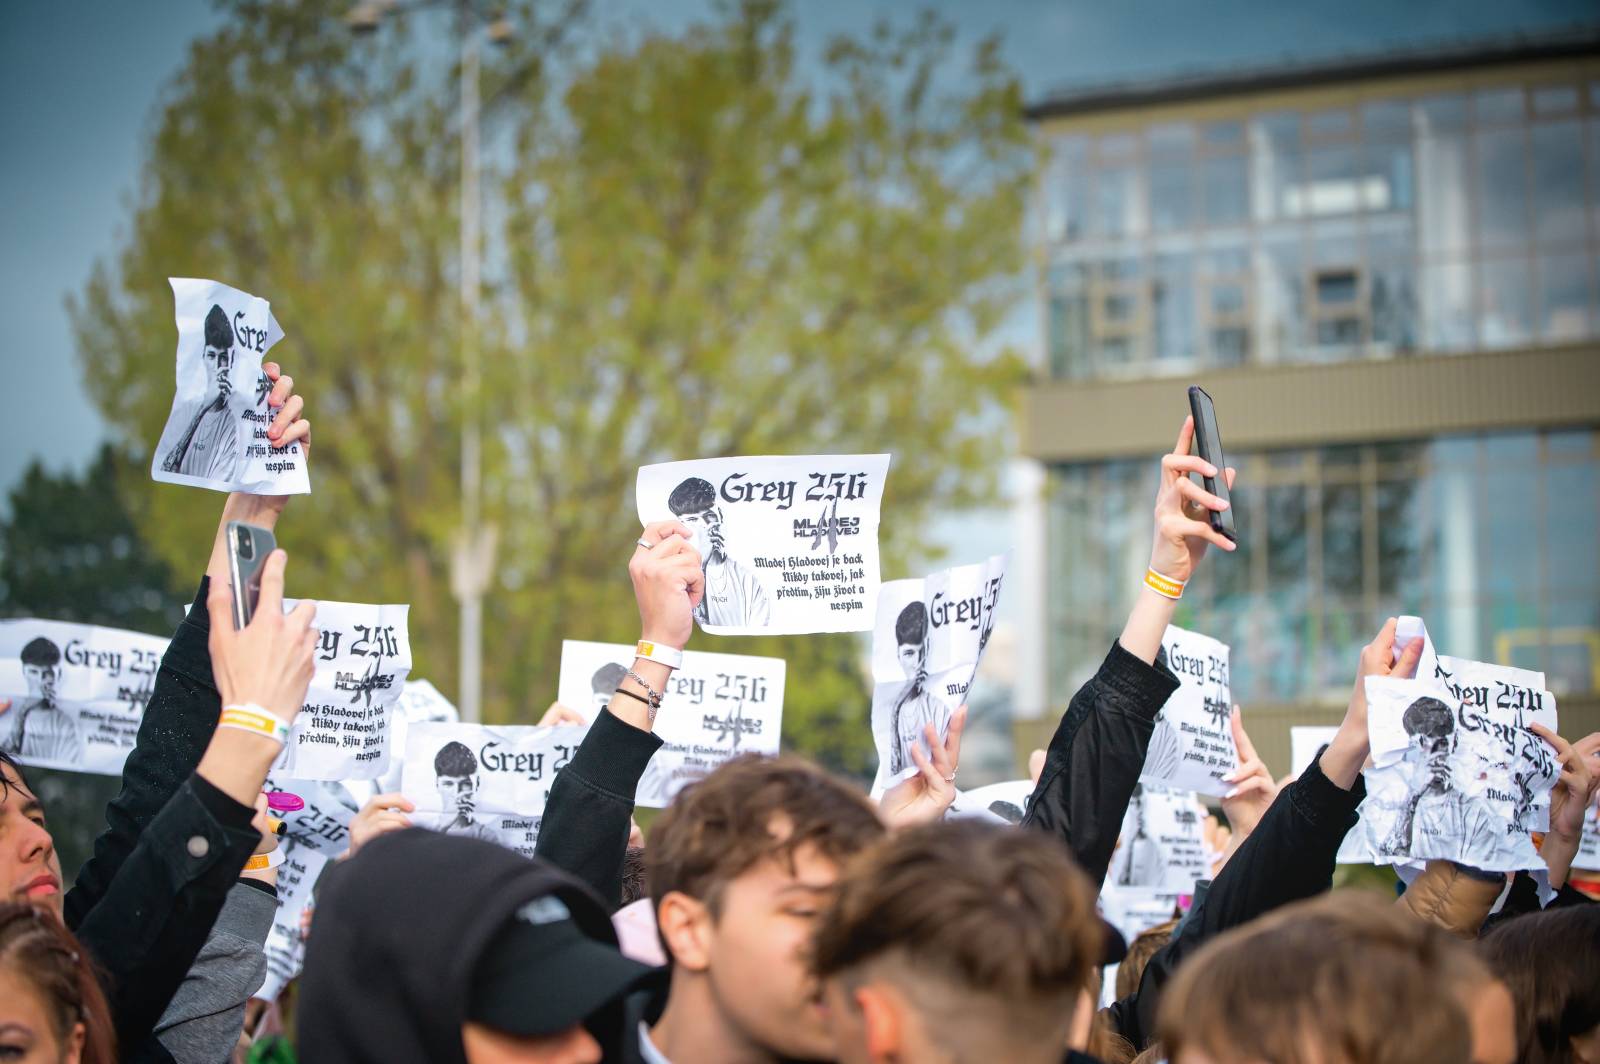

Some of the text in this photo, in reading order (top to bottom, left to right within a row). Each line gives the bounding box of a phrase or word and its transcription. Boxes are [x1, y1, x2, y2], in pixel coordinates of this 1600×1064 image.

[234, 311, 267, 353] Gre
[720, 472, 868, 510] Grey 256
[793, 517, 860, 529] MLADEJ
[793, 528, 860, 538] HLADVEJ
[754, 553, 864, 570] Mladej Hladovej je back
[782, 568, 865, 584] Nikdy takovej, jak
[814, 585, 831, 599] žiju
[833, 584, 856, 598] život
[858, 586, 865, 594] a
[930, 592, 983, 631] Grey
[351, 624, 399, 658] 256
[65, 639, 157, 677] Grey 25
[1170, 643, 1205, 686] Grey
[664, 673, 768, 704] rey 256
[299, 703, 320, 716] adej
[322, 705, 366, 721] Hladovej
[311, 717, 341, 732] Nikdy
[342, 735, 361, 748] žiju
[480, 741, 544, 781] Grey
